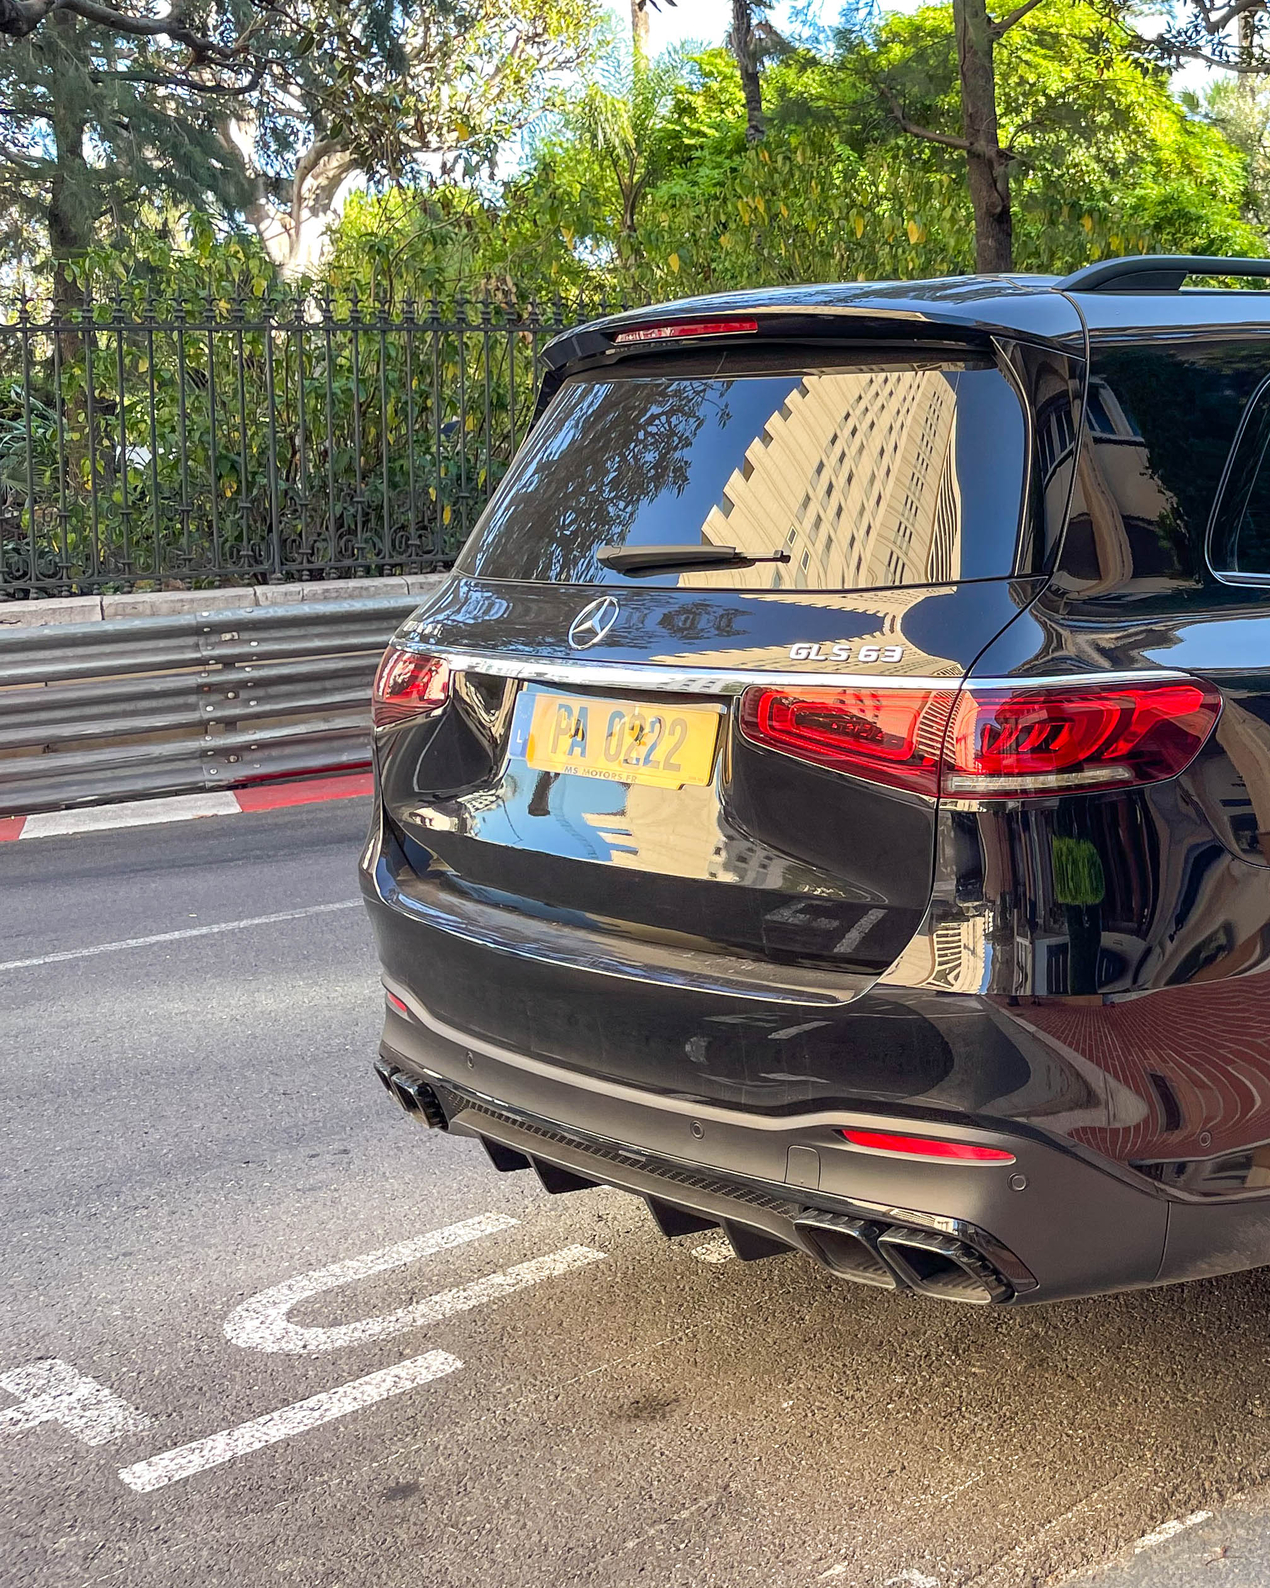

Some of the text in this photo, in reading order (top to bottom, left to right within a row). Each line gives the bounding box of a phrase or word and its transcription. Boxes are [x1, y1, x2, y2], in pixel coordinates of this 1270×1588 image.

[789, 643, 904, 663] GLS 63
[516, 729, 523, 743] L
[550, 703, 688, 772] PA 0222
[563, 765, 579, 775] MS
